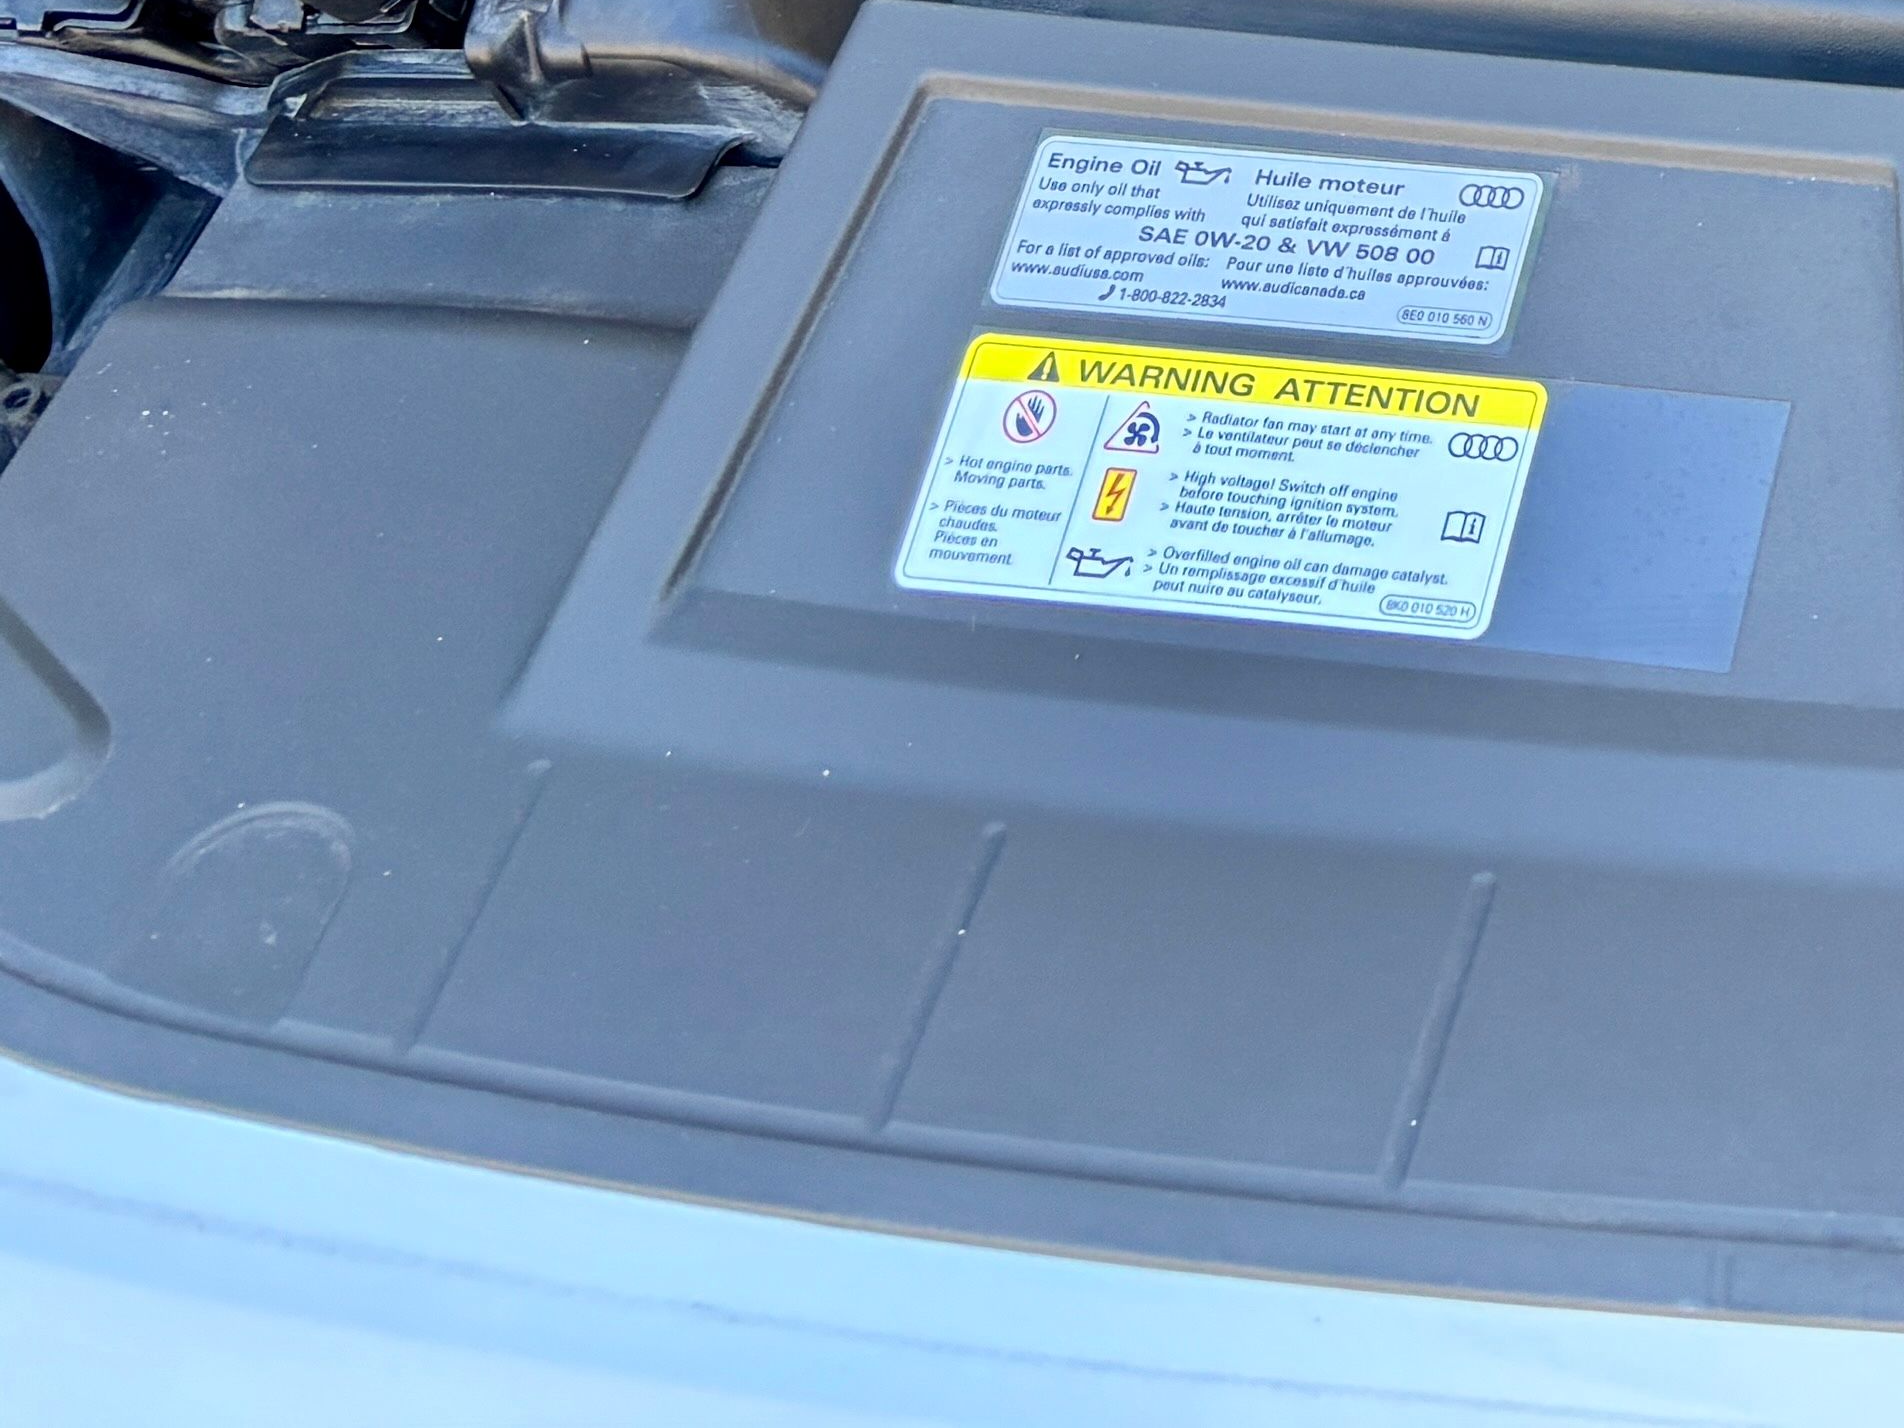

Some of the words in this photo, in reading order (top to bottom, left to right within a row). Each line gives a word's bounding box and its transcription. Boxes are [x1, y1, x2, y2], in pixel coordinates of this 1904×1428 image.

[1048, 152, 1123, 174] Engine
[1131, 159, 1162, 176] Oil
[1039, 176, 1067, 192] Use
[1071, 180, 1104, 197] only
[1107, 182, 1126, 196] oil
[1131, 184, 1161, 199] that
[1254, 169, 1312, 188] Huile
[1318, 177, 1405, 196] moteur
[1033, 198, 1101, 215] expressly
[1104, 204, 1170, 220] complies
[1175, 208, 1206, 223] with
[1247, 193, 1301, 211] Utilisez
[1304, 197, 1394, 219] uniquement
[1398, 206, 1416, 220] de
[1241, 214, 1265, 229] qui
[1269, 215, 1328, 233] satisfait
[1331, 221, 1437, 242] expressément
[1016, 239, 1042, 255] For
[1045, 245, 1054, 256] a
[1059, 242, 1080, 258] list
[1084, 245, 1101, 259] of
[1103, 247, 1173, 266] approved
[1177, 252, 1210, 268] oils:
[1138, 225, 1189, 245] SAE
[1194, 230, 1271, 251] 0W-20
[1277, 237, 1297, 254] &
[1307, 239, 1350, 258] VW
[1356, 244, 1399, 262] 508
[1406, 248, 1435, 265] 00
[1011, 261, 1144, 282] www.audiusa.com
[1226, 257, 1262, 273] Pour
[1265, 261, 1293, 275] une
[1298, 262, 1330, 279] liste
[1396, 272, 1489, 292] approuvées:
[1119, 287, 1227, 309] 1-800-822-2834
[1221, 278, 1366, 301] www.audicanada.ca
[1427, 310, 1450, 324] 010
[1477, 315, 1488, 327] N
[1080, 359, 1256, 397] WARNING
[1274, 377, 1480, 417] ATTENTION
[1202, 411, 1260, 429] Radiator
[1263, 416, 1285, 431] fan
[1287, 420, 1318, 436] may
[1321, 421, 1352, 437] start
[1354, 425, 1369, 438] at
[1371, 428, 1397, 443] any
[1400, 430, 1433, 445] time.
[1198, 427, 1215, 441] Le
[1218, 429, 1289, 447] ventilateur
[1292, 434, 1324, 451] peut
[1326, 439, 1342, 451] se
[1345, 439, 1421, 459] déclencher
[1204, 443, 1232, 458] tout
[1235, 447, 1295, 463] moment.
[959, 455, 983, 469] Hot
[986, 458, 1033, 474] engine
[1035, 462, 1073, 477] parts.
[954, 471, 1005, 488] Moving
[1008, 477, 1046, 491] parts.
[1184, 470, 1217, 488] High
[1220, 475, 1276, 493] voltage!
[1278, 479, 1325, 496] Switch
[1328, 483, 1350, 498] off
[1351, 488, 1399, 503] engine
[990, 503, 1008, 517] du
[1011, 508, 1062, 523] moteur
[1179, 486, 1224, 502] before
[1227, 490, 1287, 510] touching
[1290, 497, 1343, 515] ignition
[1346, 502, 1399, 519] system.
[939, 517, 998, 532] chaudes.
[1170, 517, 1209, 532] avant
[1211, 520, 1230, 534] de
[1232, 522, 1285, 539] toucher
[1174, 500, 1216, 517] Haute
[1218, 505, 1272, 523] tension,
[1276, 510, 1323, 527] arrêter
[1326, 514, 1339, 528] le
[1342, 518, 1393, 533] moteur
[980, 535, 999, 547] en
[1159, 562, 1180, 575] Un
[1182, 566, 1266, 585] remplissage
[1269, 574, 1326, 590] excessif
[1163, 546, 1231, 565] Overfilled
[1233, 553, 1280, 571] engine
[1283, 557, 1301, 571] oil
[1304, 562, 1330, 574] can
[1333, 563, 1389, 581] damage
[1392, 568, 1449, 585] catalyst.
[1153, 580, 1184, 594] peut
[1187, 582, 1224, 597] nuire
[1227, 587, 1244, 598] au
[1247, 588, 1322, 605] catalyseur.
